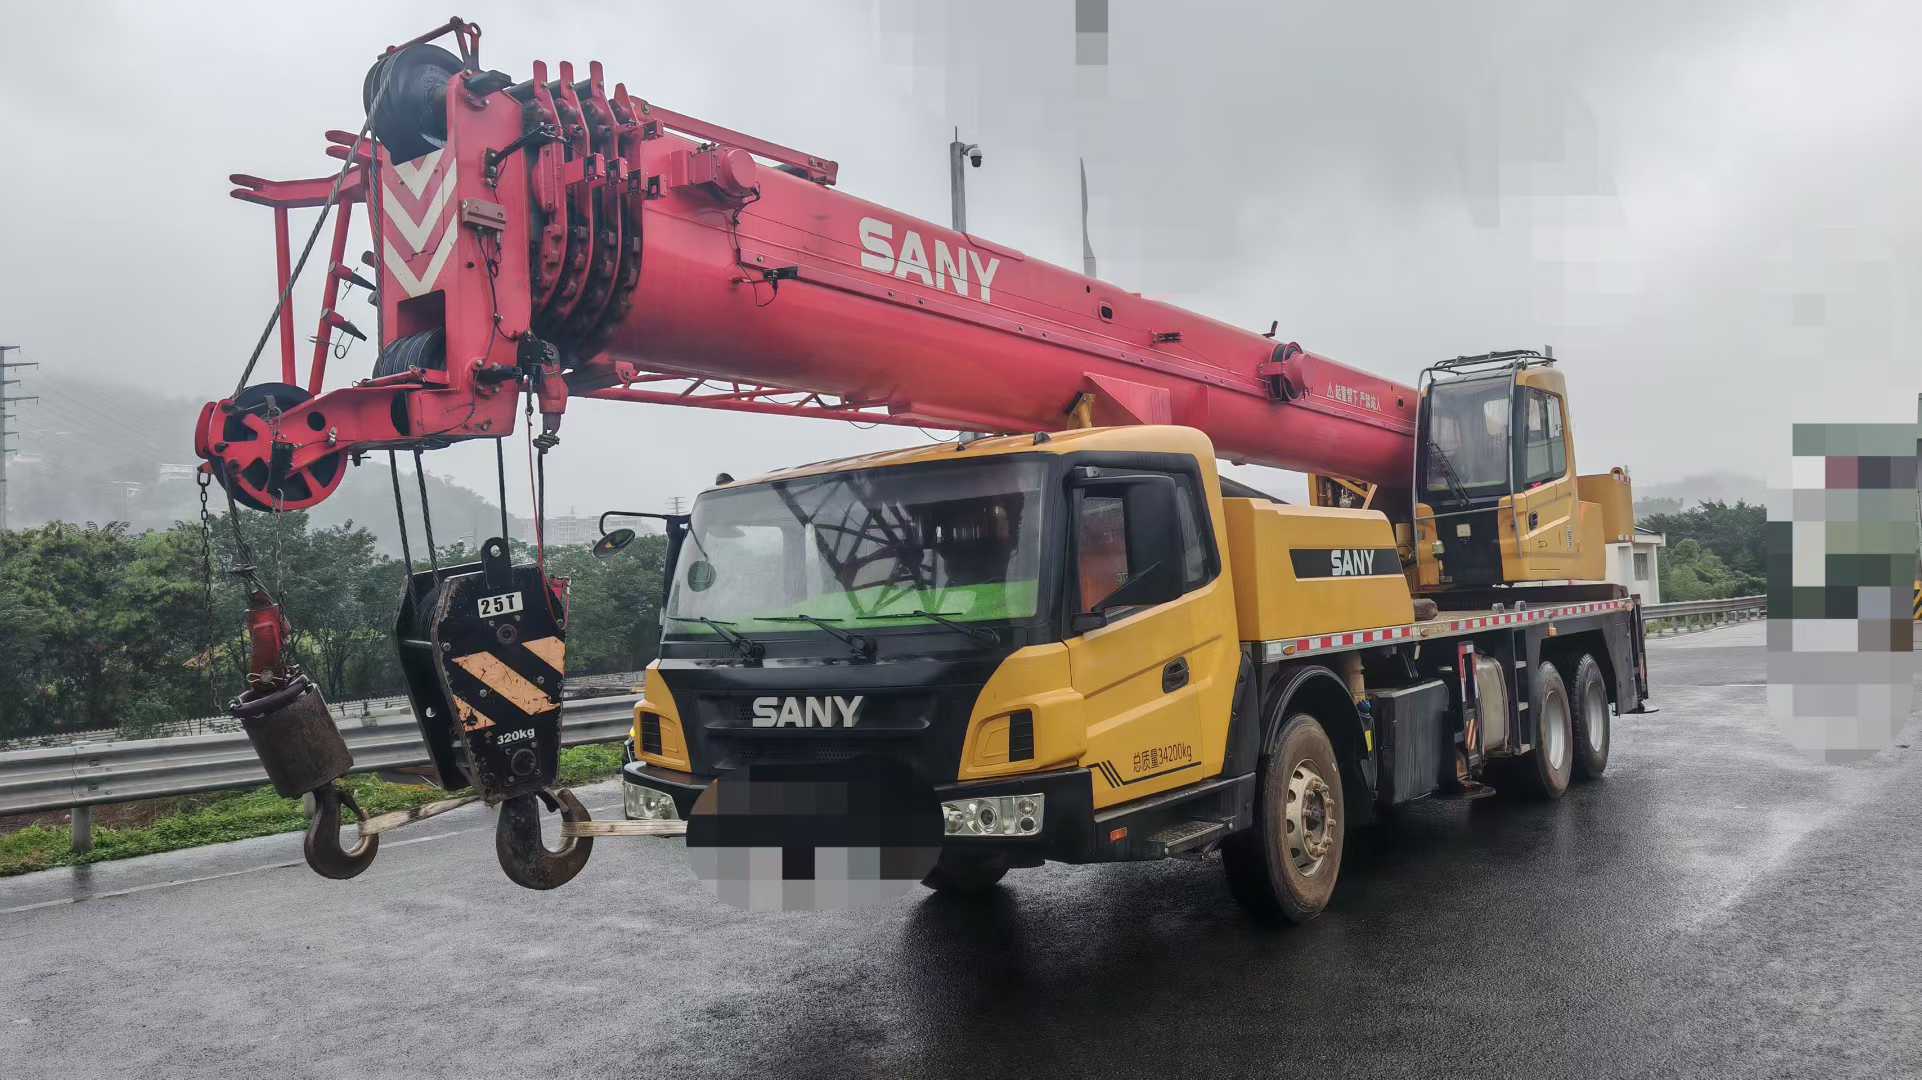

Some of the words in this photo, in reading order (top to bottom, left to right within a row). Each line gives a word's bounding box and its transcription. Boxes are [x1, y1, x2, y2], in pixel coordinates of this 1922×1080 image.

[859, 217, 1000, 303] SANY
[1331, 549, 1375, 576] SANY
[481, 595, 515, 615] 25T
[752, 696, 864, 728] SANY
[497, 728, 535, 744] 320kg
[1133, 743, 1193, 772] 总质量34200kg
